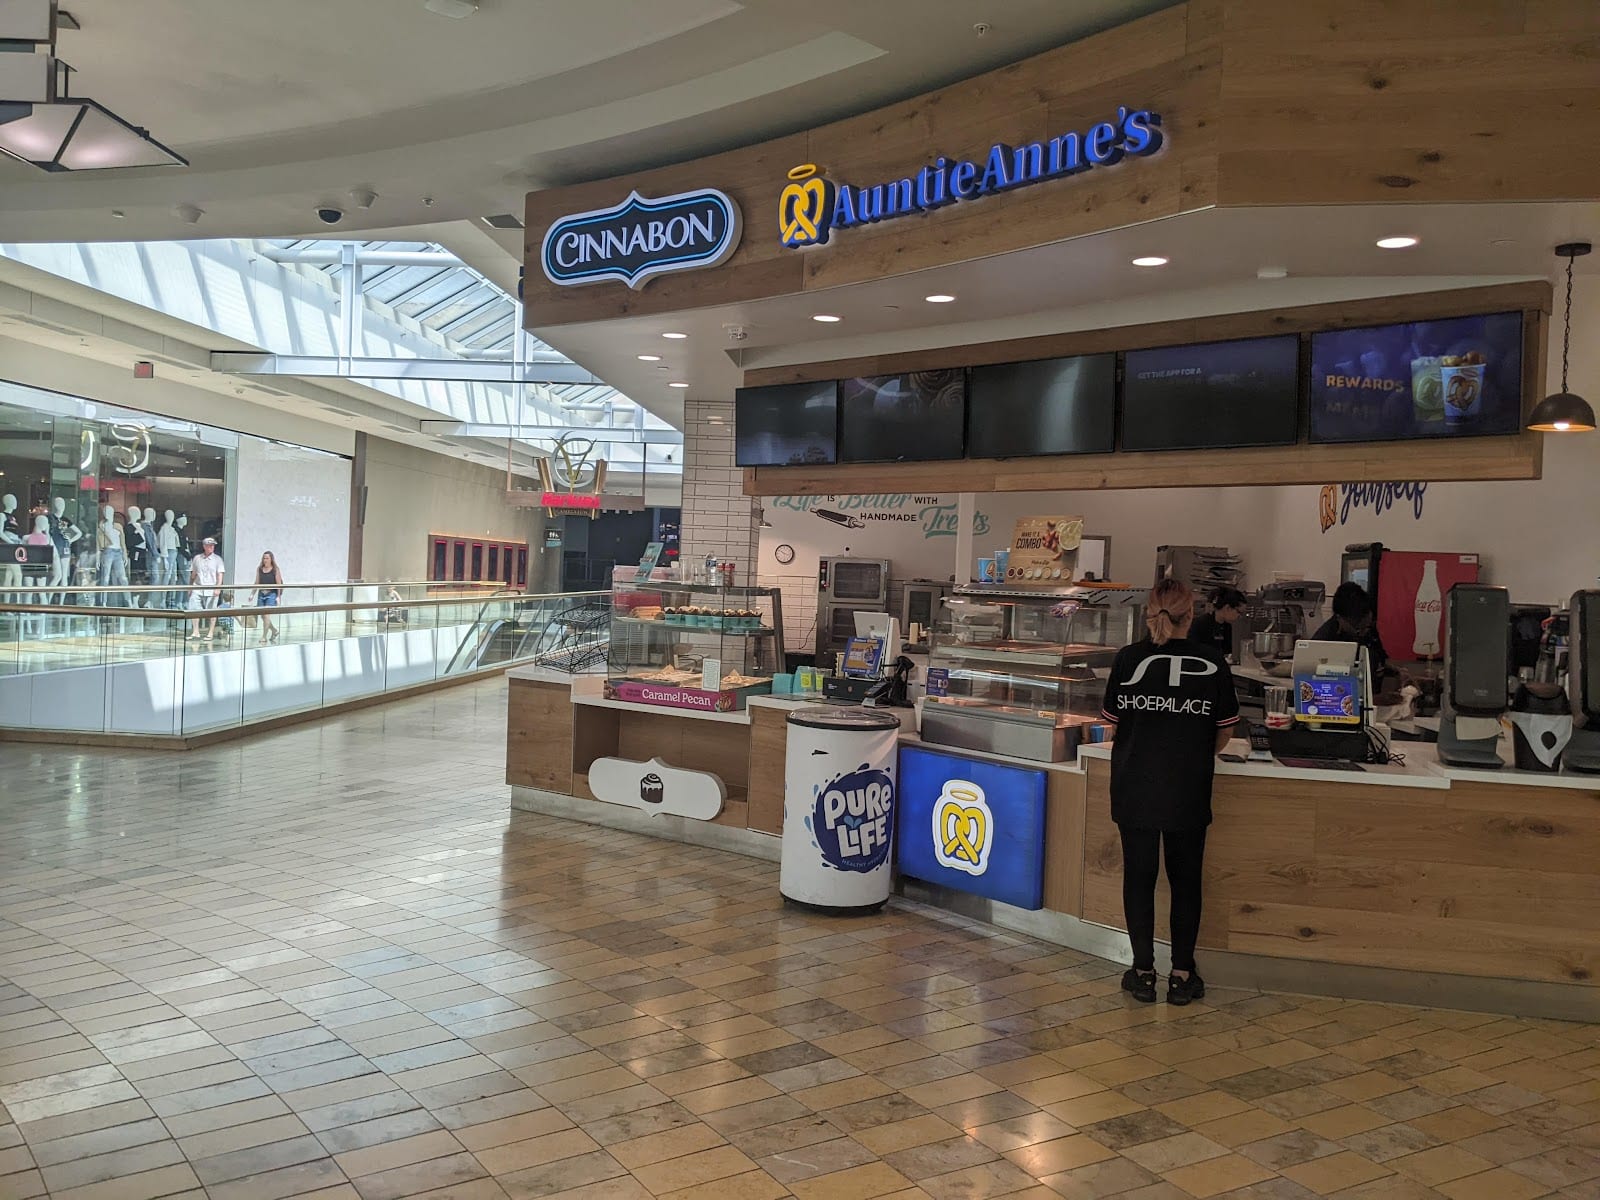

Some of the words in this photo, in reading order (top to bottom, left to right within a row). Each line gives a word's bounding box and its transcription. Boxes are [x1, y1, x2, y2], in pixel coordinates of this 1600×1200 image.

[556, 210, 713, 267] CINNABON
[1326, 374, 1404, 393] REWARDS
[860, 512, 918, 522] HANDMADE
[919, 504, 990, 539] Trets
[1016, 538, 1042, 549] COMBO
[642, 688, 680, 703] Caramel
[682, 693, 711, 706] Pecan
[1117, 694, 1212, 715] SHOEPALACE
